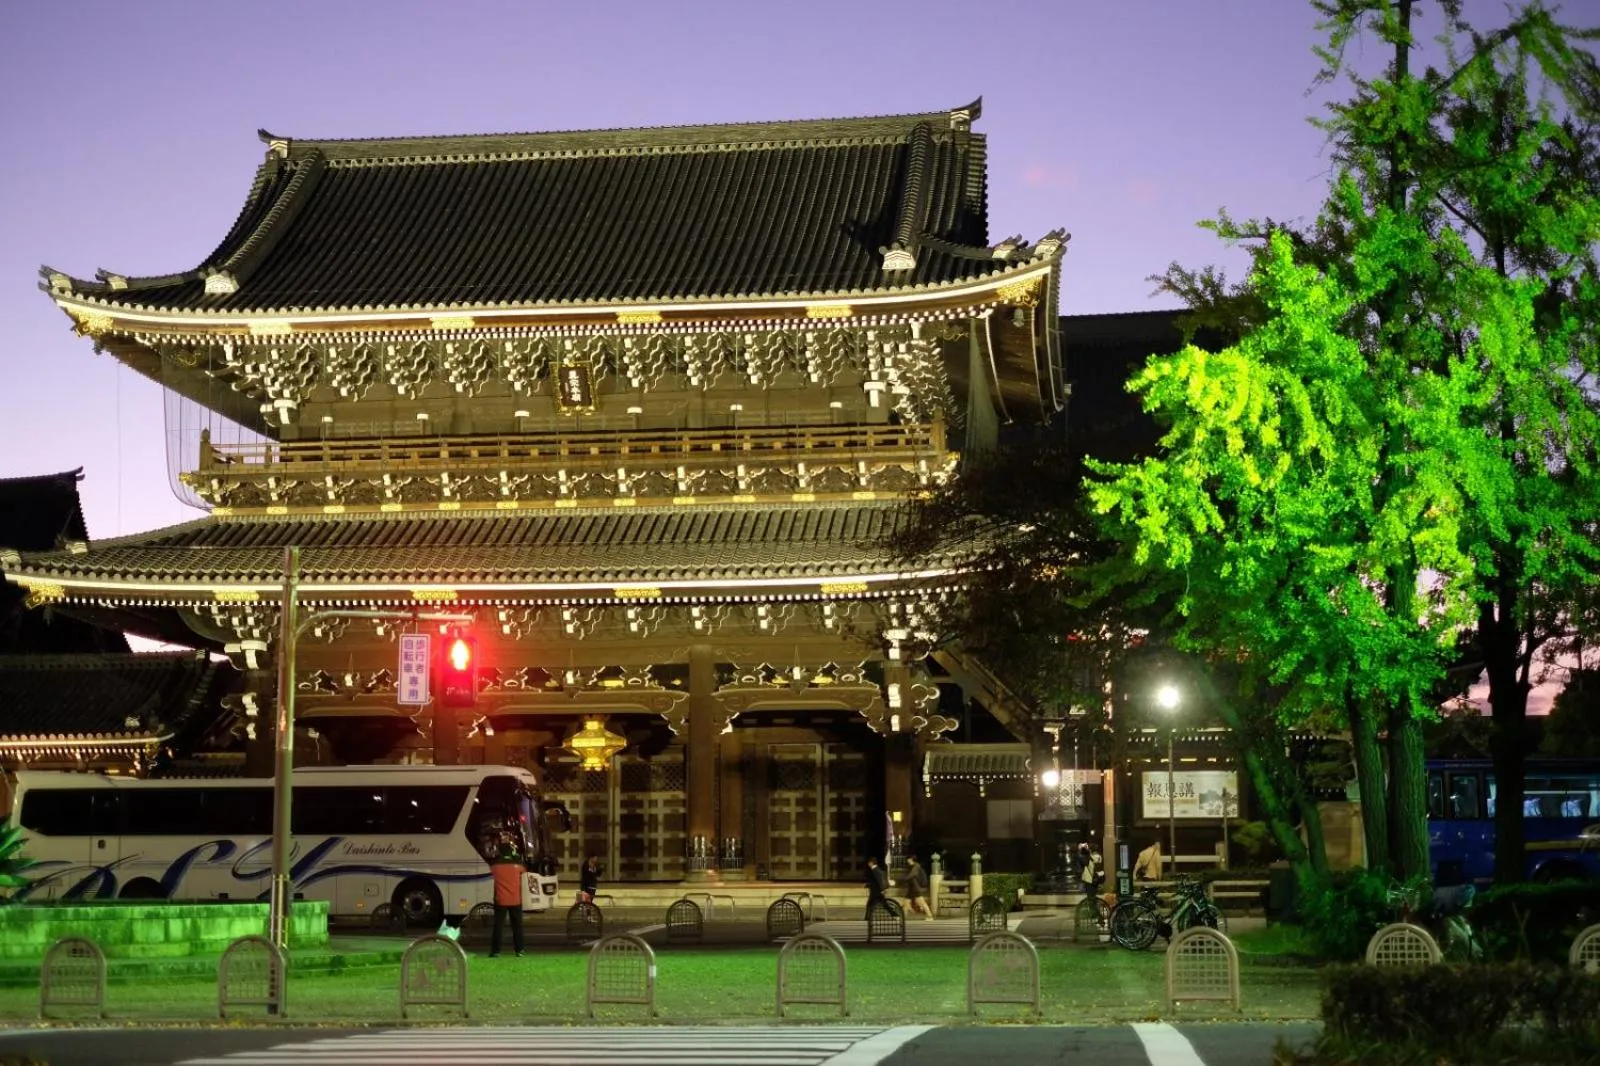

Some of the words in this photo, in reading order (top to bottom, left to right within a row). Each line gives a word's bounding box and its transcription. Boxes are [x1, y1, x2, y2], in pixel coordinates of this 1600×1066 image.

[415, 639, 425, 674] 歩行者
[397, 841, 421, 856] Bus
